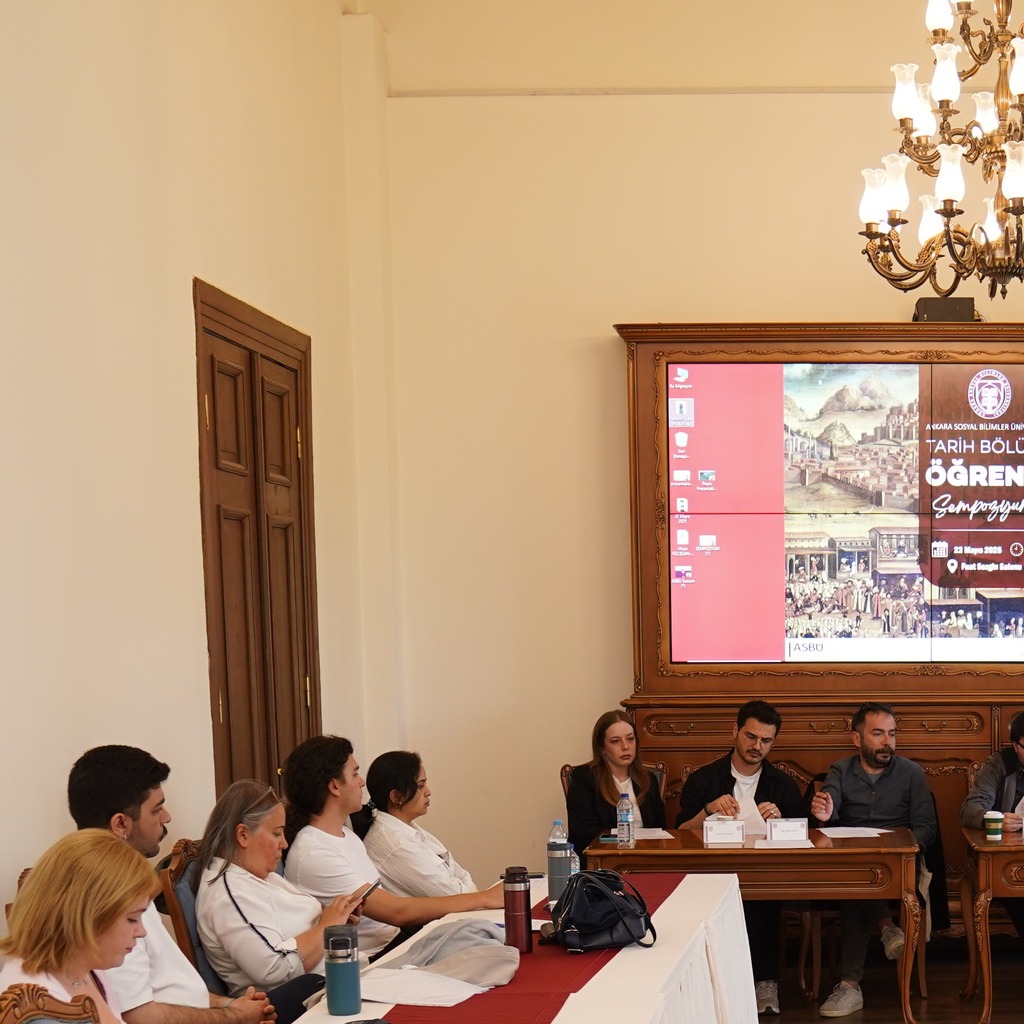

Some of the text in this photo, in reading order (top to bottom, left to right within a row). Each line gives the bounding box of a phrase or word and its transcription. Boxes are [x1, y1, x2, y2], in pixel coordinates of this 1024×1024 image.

[925, 423, 953, 431] ANKARA
[953, 423, 978, 431] SOSYAL
[979, 422, 1010, 431] BİLİMLER
[925, 437, 975, 454] TARİH
[953, 546, 963, 554] 22
